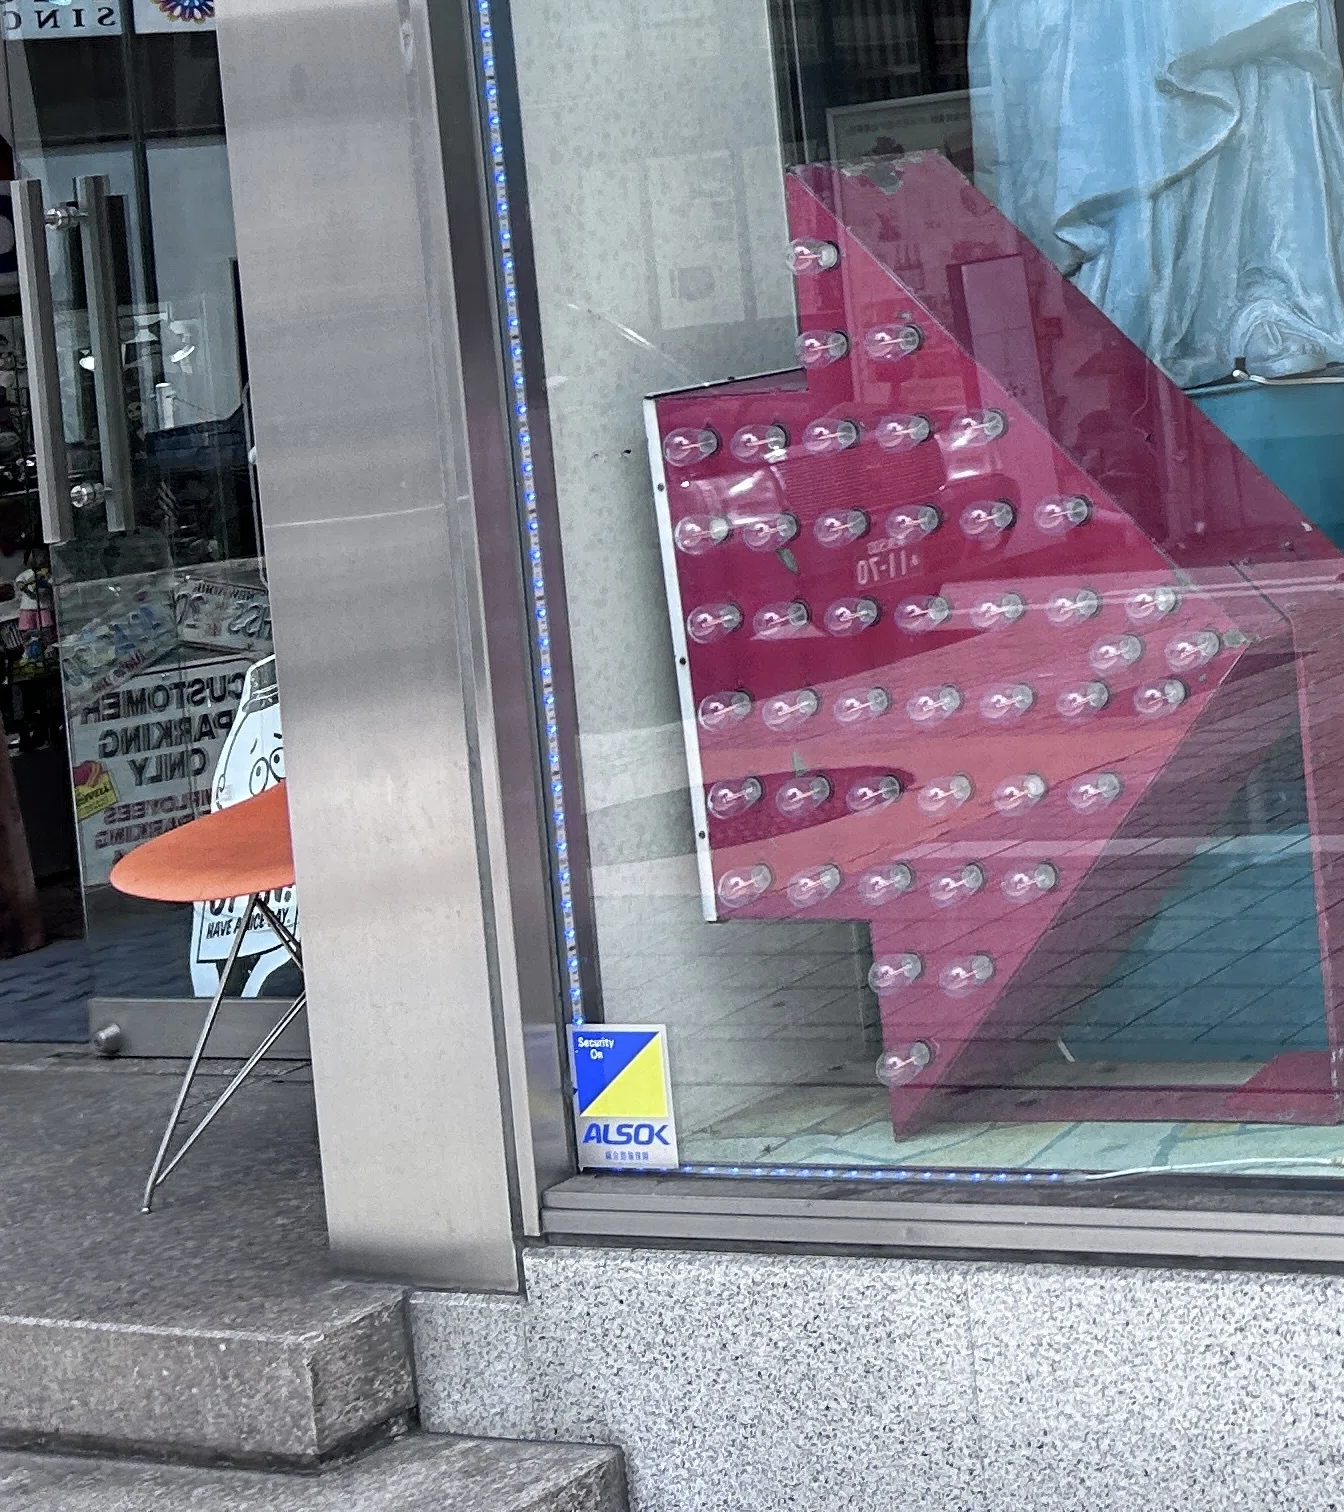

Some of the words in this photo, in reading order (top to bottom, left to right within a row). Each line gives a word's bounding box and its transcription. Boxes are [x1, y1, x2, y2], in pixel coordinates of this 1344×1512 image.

[206, 918, 233, 940] HAVE
[578, 1036, 614, 1049] Security
[590, 1049, 603, 1059] On
[583, 1122, 671, 1146] ALSOK
